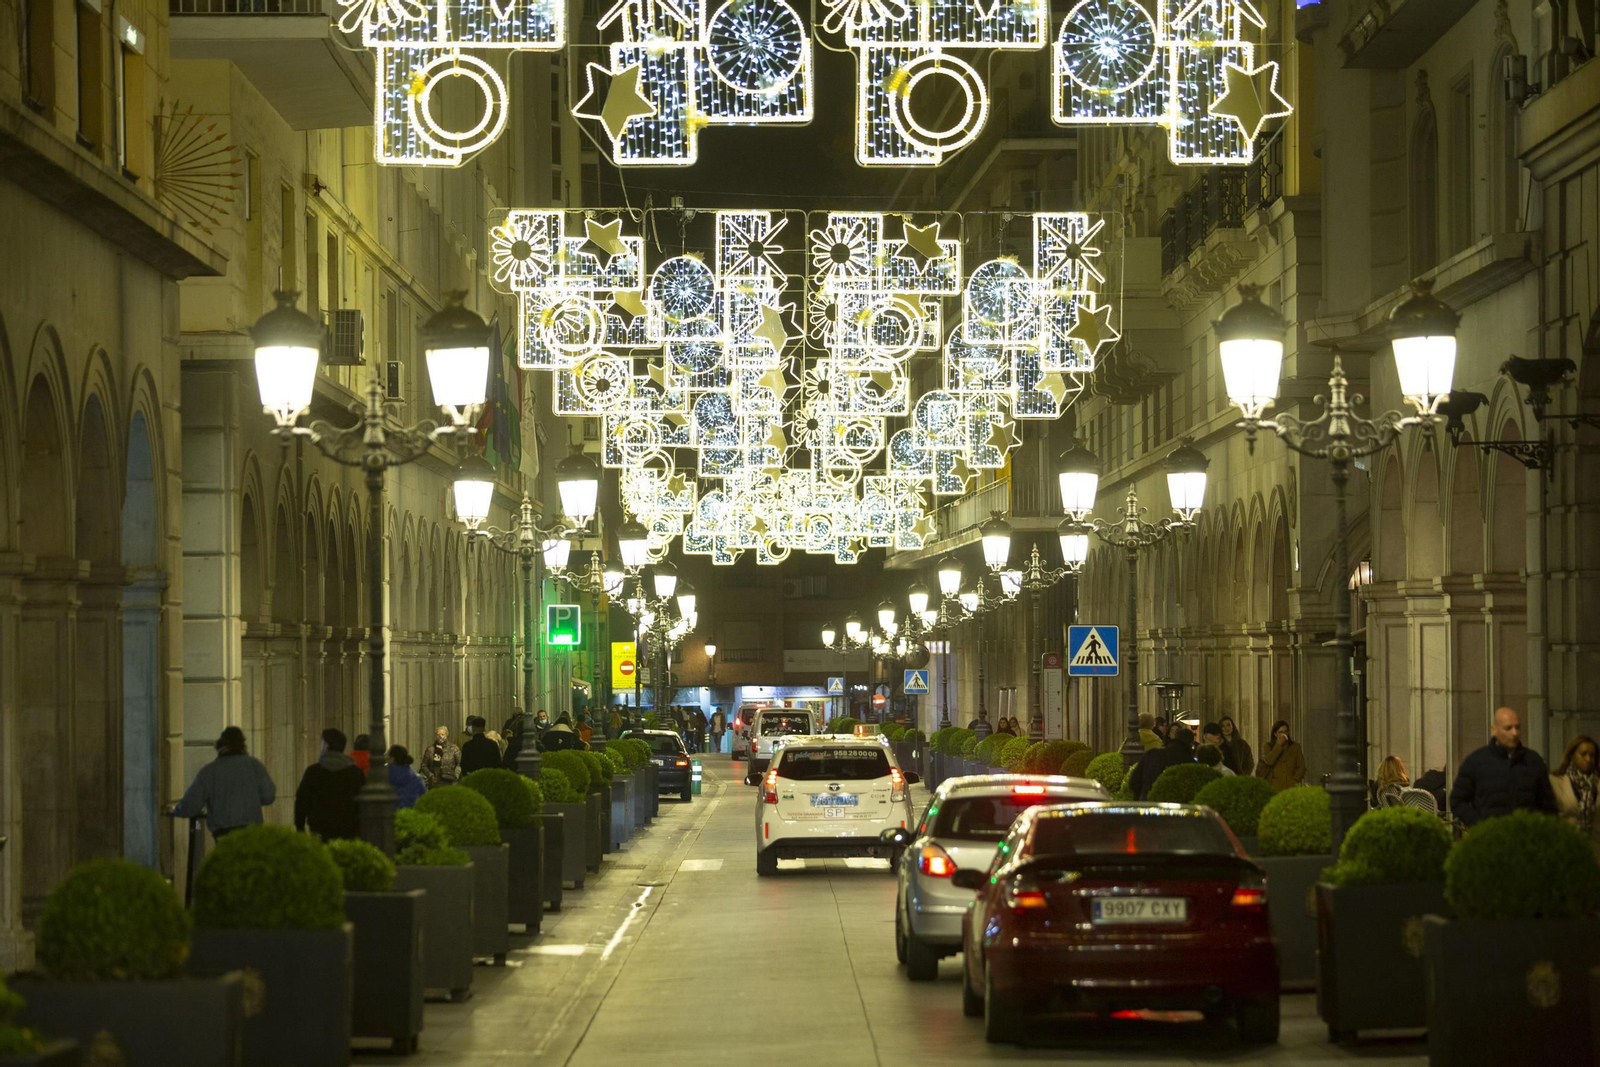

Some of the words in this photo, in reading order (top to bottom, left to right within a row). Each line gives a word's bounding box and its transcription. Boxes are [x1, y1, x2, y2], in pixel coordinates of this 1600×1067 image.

[556, 606, 571, 628] P
[827, 808, 842, 817] SP
[1104, 901, 1144, 916] 9907
[1151, 901, 1180, 915] CXY
